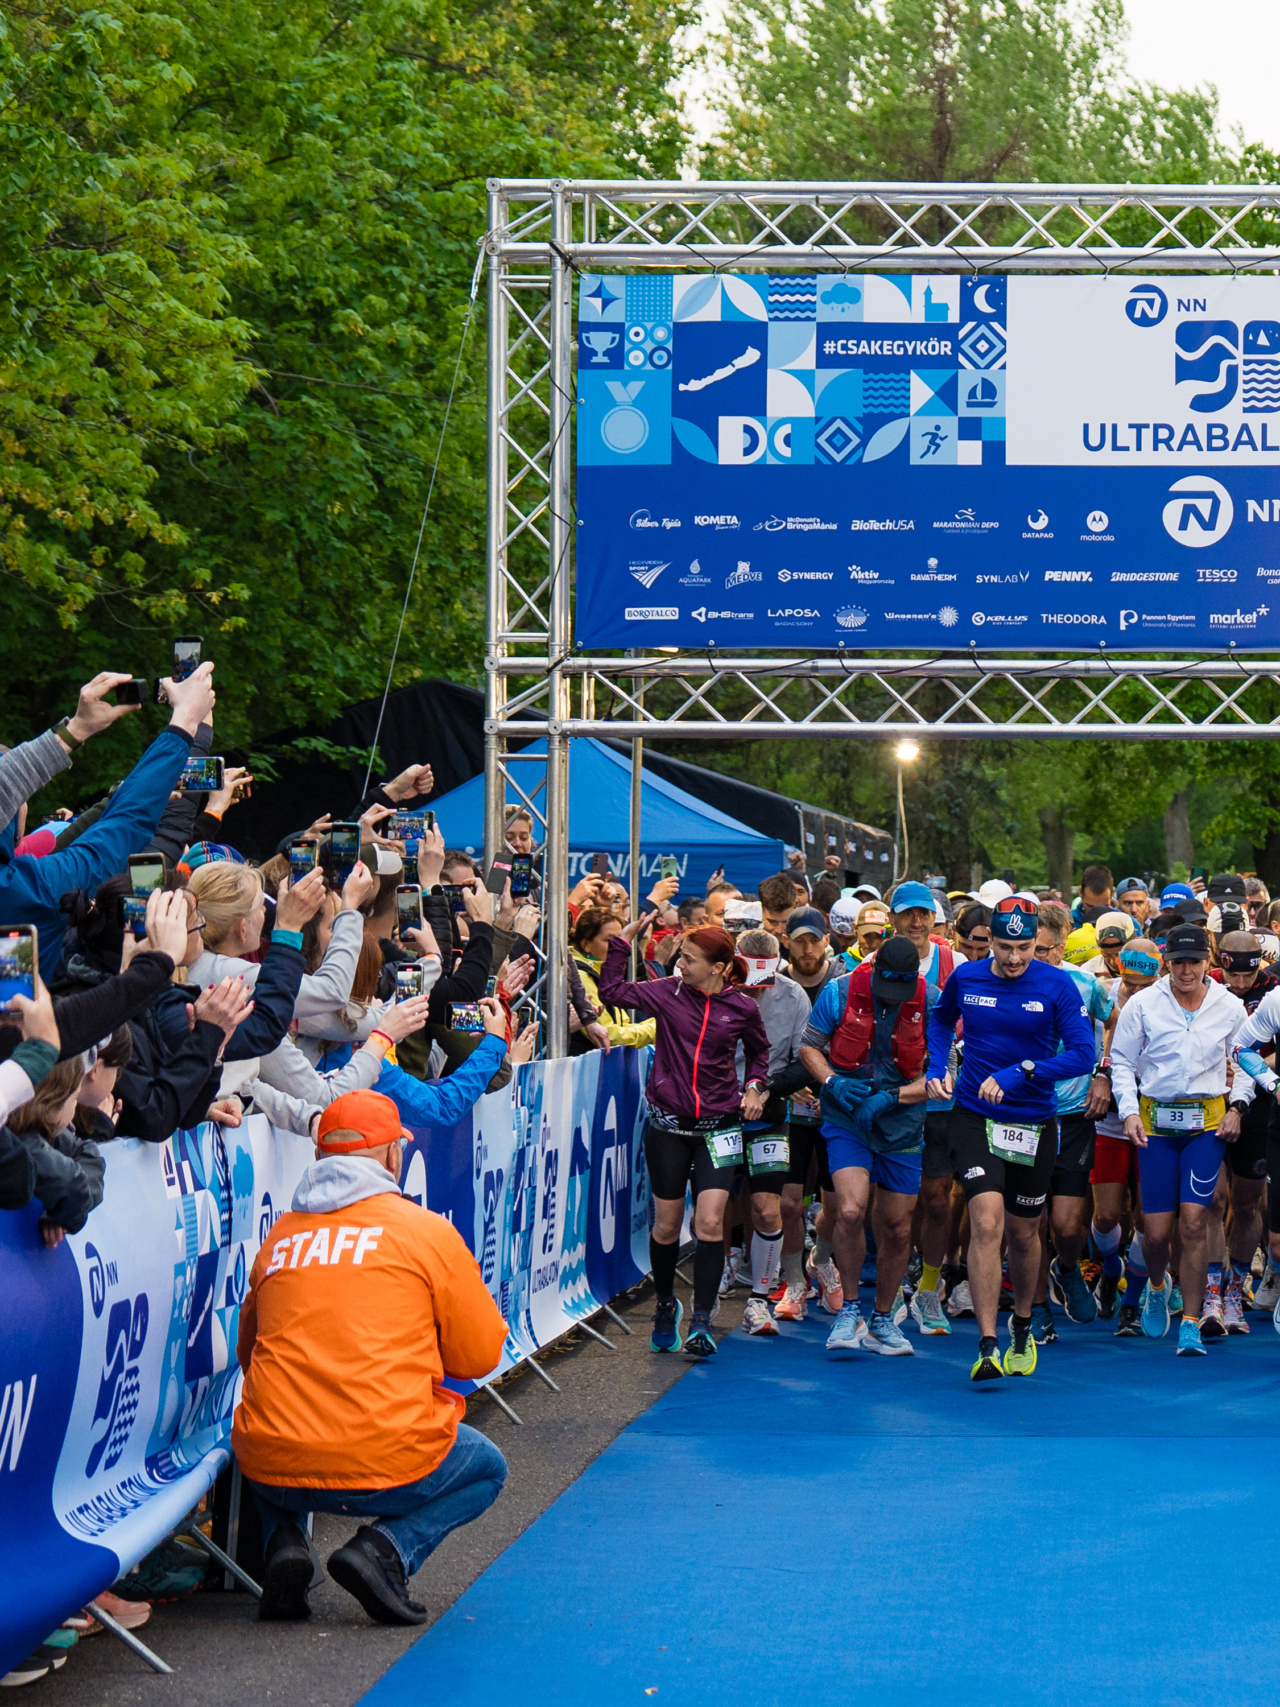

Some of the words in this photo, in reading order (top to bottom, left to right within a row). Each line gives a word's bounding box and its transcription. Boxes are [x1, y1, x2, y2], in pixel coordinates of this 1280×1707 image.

[1176, 298, 1208, 313] NN
[823, 338, 953, 356] #CSAKEGYKÖR
[694, 515, 739, 526] KOMETA
[787, 521, 838, 531] BringaMánia
[851, 519, 916, 531] BioTechUSA
[1080, 534, 1115, 542] motorola
[792, 571, 834, 580] SYNERGY
[910, 574, 957, 582] RAVATHERM
[975, 574, 1019, 584] SYNLAB
[1044, 570, 1094, 582] PENNY.
[1110, 571, 1180, 582] BRIDGESTONE
[1196, 569, 1238, 579] TESCO
[724, 571, 764, 590] MEDVE
[627, 609, 678, 619] BOROTALCO
[767, 608, 821, 618] LAPOSA
[1040, 613, 1107, 625] THEODORA
[1166, 614, 1196, 622] Egyetem
[1209, 608, 1258, 625] market
[1121, 957, 1161, 973] FINISHER
[964, 995, 979, 1004] RACE
[979, 997, 998, 1007] PACE
[1169, 1110, 1184, 1122] 33
[1002, 1128, 1024, 1144] 184
[762, 1143, 777, 1155] 67
[265, 1226, 384, 1276] STAFF
[105, 1261, 119, 1287] NN
